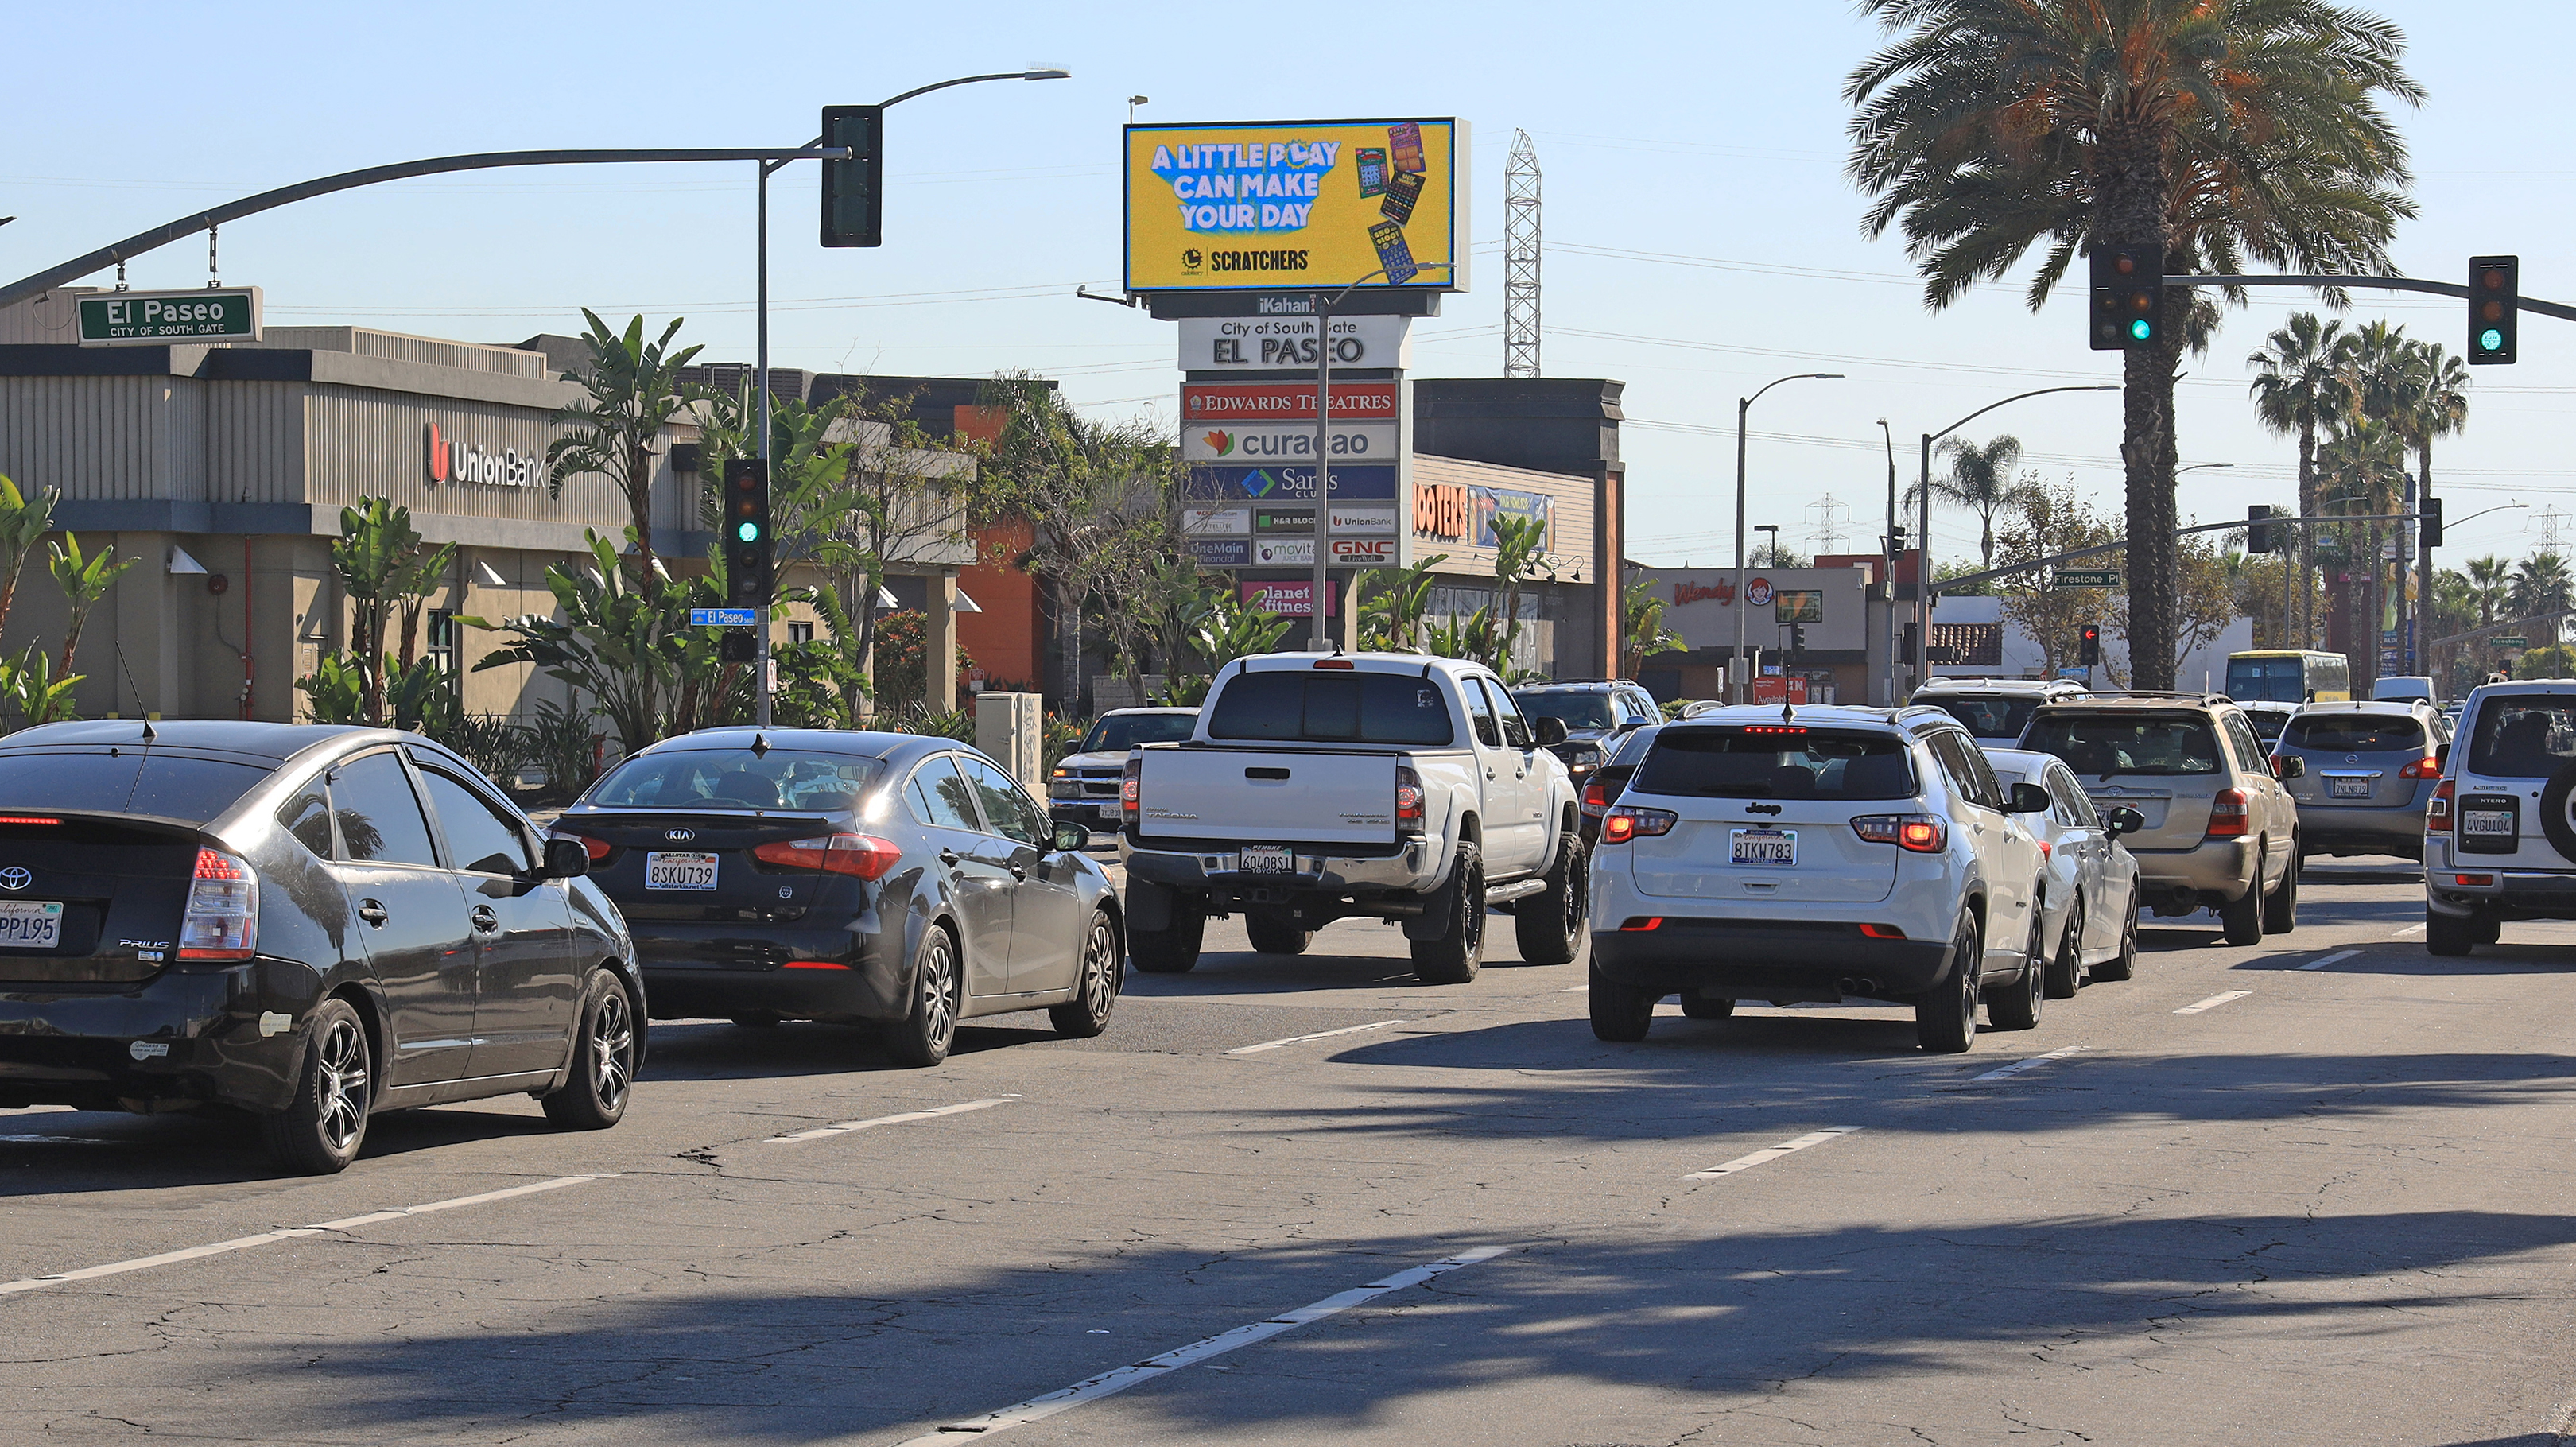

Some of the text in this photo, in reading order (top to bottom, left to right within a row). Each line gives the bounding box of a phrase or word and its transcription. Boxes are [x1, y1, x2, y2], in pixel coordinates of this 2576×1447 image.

[1151, 141, 1341, 169] A LITTLE PLAY
[1174, 173, 1319, 199] CAN MAKE
[1178, 203, 1313, 229] YOUR DAY
[1211, 250, 1309, 272] SCRATCHERS
[107, 299, 224, 324] El Paseo
[1259, 297, 1310, 313] iKahan
[110, 324, 225, 338] CITY OF SOUTH GATE
[1221, 320, 1356, 337] City of South ate
[1213, 338, 1248, 364] EL
[1205, 395, 1292, 411] EDWARDS
[455, 441, 545, 488] UnionBank
[1190, 542, 1243, 553] OneMain
[1332, 541, 1394, 554] GNC
[1199, 554, 1235, 563] Financial
[2054, 574, 2119, 584] Firestone Pl
[1674, 577, 1736, 607] Wendy
[708, 611, 716, 623] El
[718, 611, 743, 623] Paseo
[1758, 695, 1787, 704] Availabl
[2336, 785, 2367, 794] 7NLN879
[1745, 802, 1782, 817] Jeep
[2467, 820, 2509, 832] 4VGU104
[669, 830, 690, 840] KIA
[1735, 843, 1791, 859] 8TKW783
[652, 867, 712, 884] 8SKU739
[119, 939, 170, 949] PRIUS
